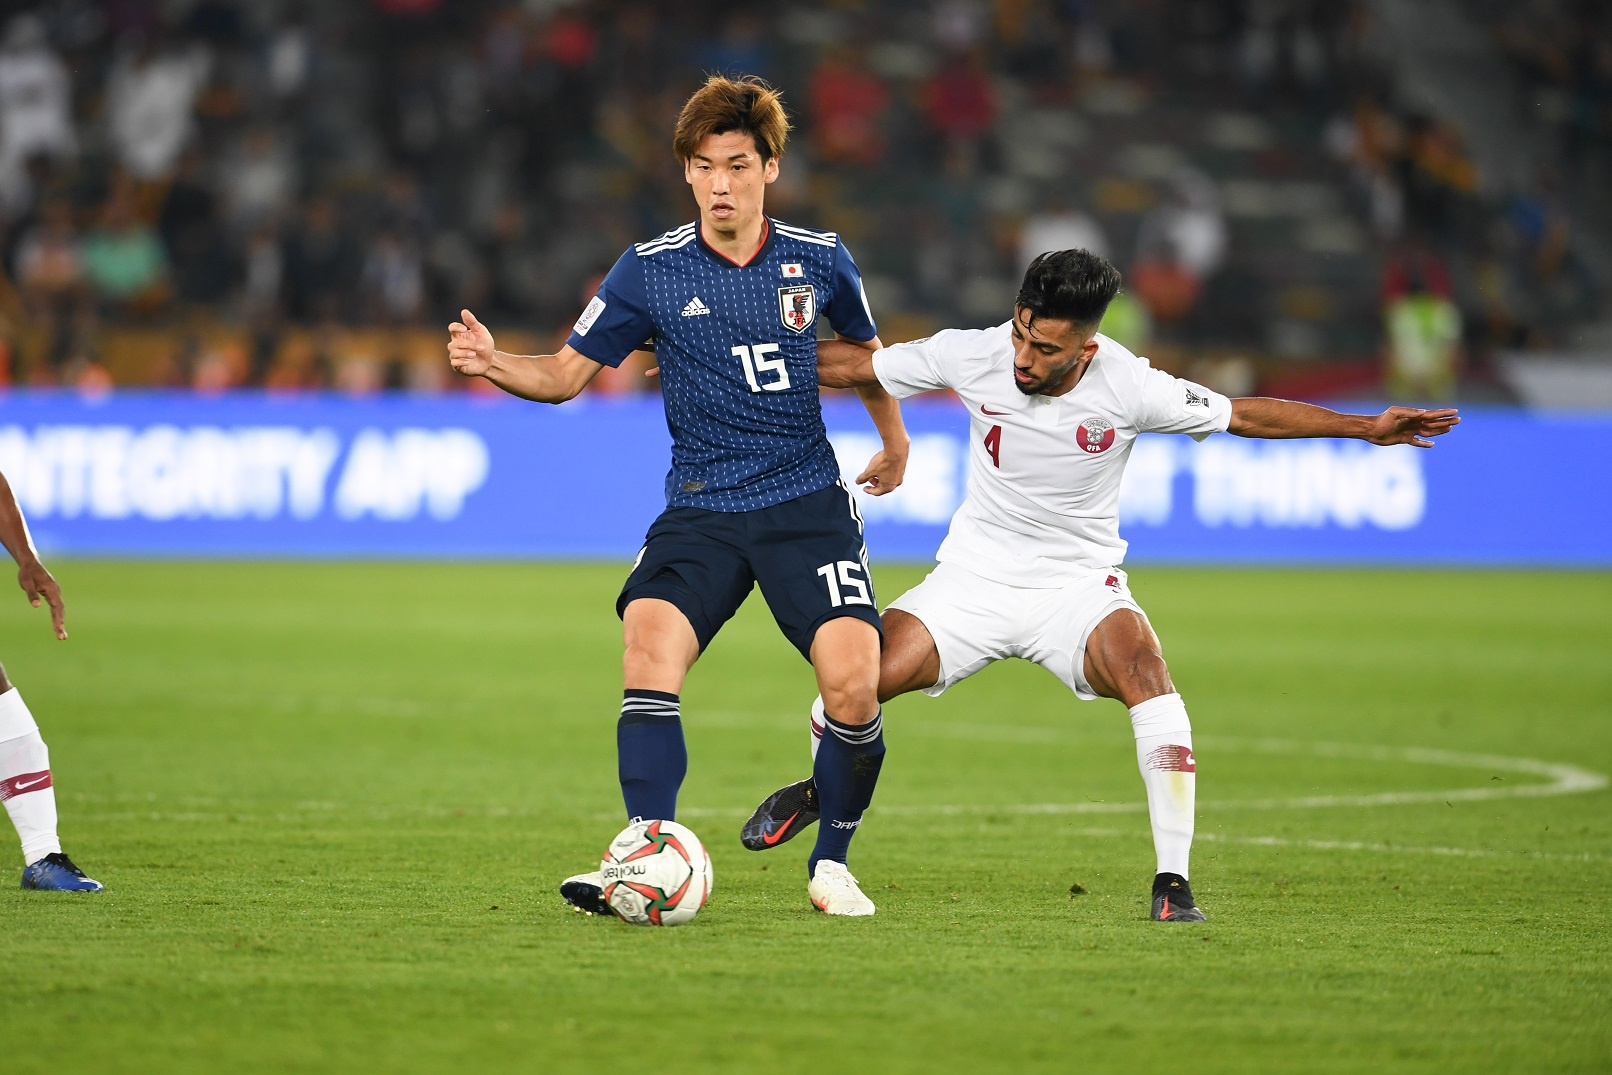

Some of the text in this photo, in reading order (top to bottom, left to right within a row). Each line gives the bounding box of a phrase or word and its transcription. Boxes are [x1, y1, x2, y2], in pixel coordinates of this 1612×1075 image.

[681, 308, 710, 317] adidas
[793, 317, 806, 325] JFA
[731, 343, 791, 392] 15
[983, 425, 1002, 469] 4
[1086, 444, 1102, 452] QFA
[817, 560, 872, 607] 15
